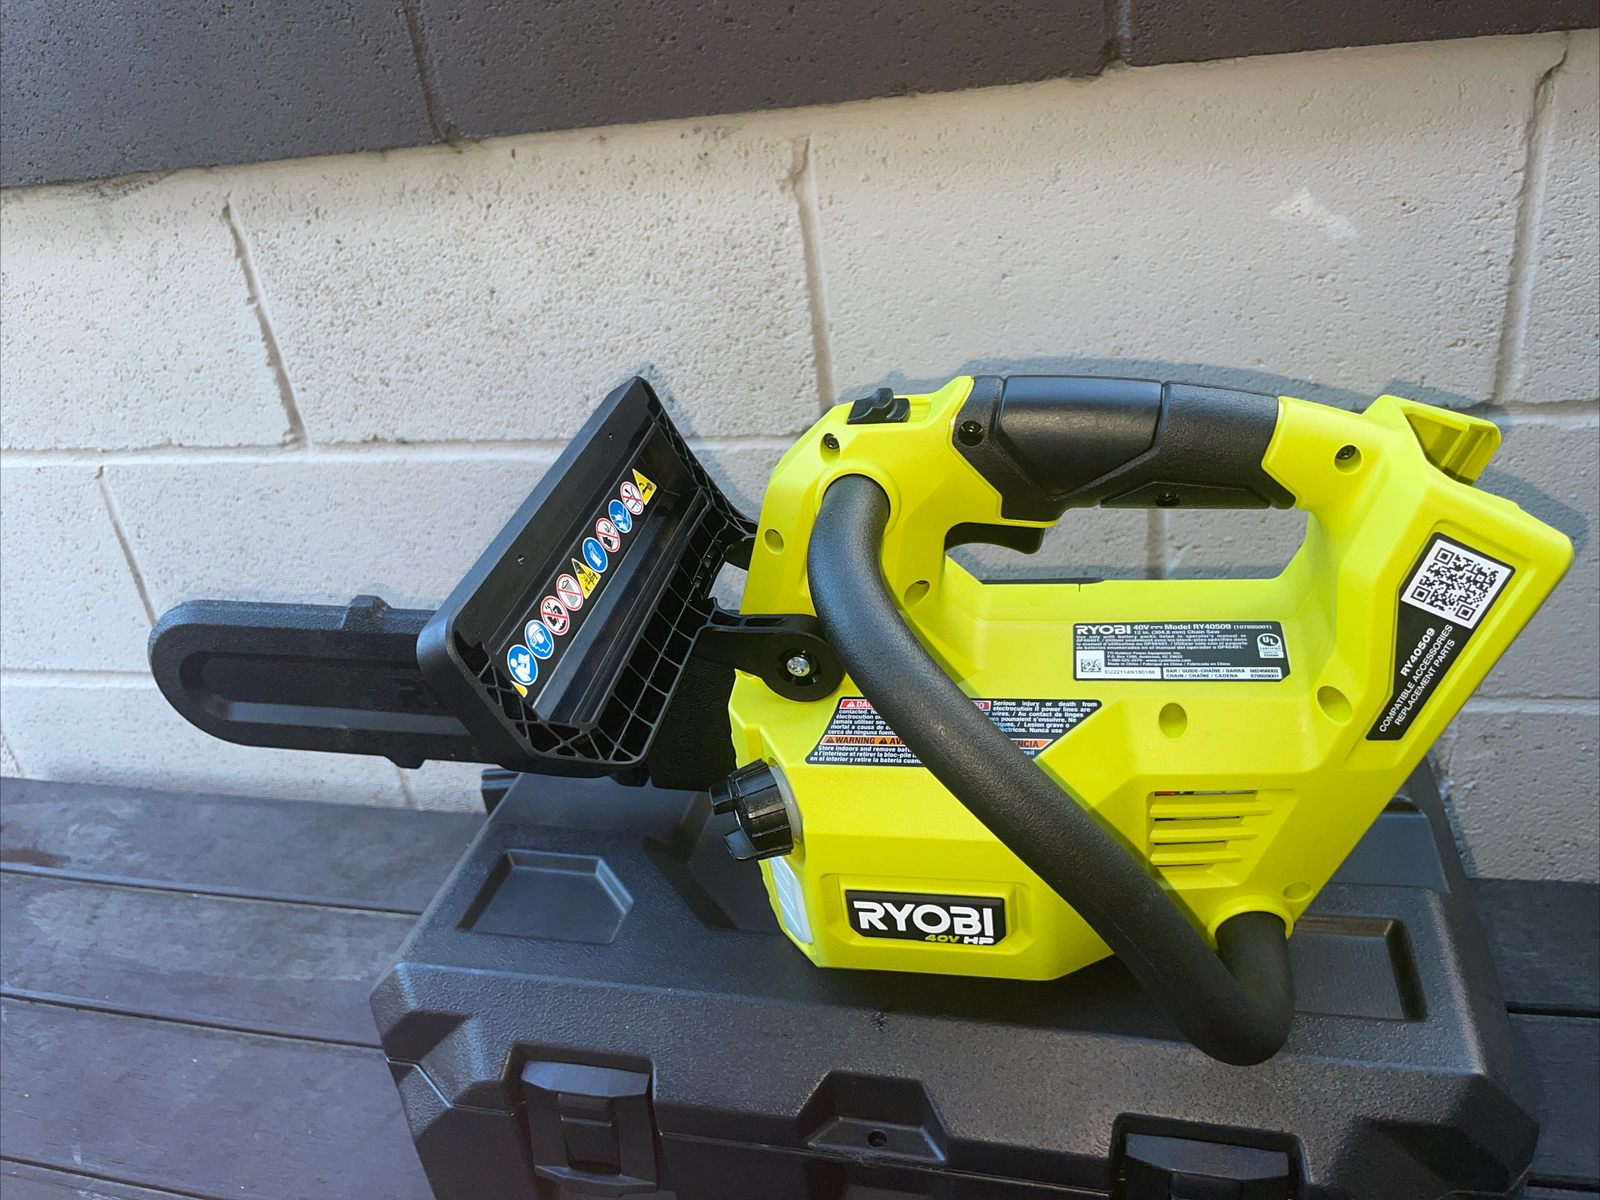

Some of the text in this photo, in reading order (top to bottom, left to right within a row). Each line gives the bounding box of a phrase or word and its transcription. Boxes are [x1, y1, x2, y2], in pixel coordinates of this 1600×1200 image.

[1075, 624, 1131, 635] RYOBI
[1400, 627, 1436, 677] RY40509
[1378, 624, 1454, 732] COMPATIBLE ACCESSORIES
[1394, 638, 1456, 726] REPLACEMENT PARTS
[836, 736, 876, 744] WARNING
[853, 900, 995, 936] RYOBI
[924, 934, 995, 945] 40V HP
